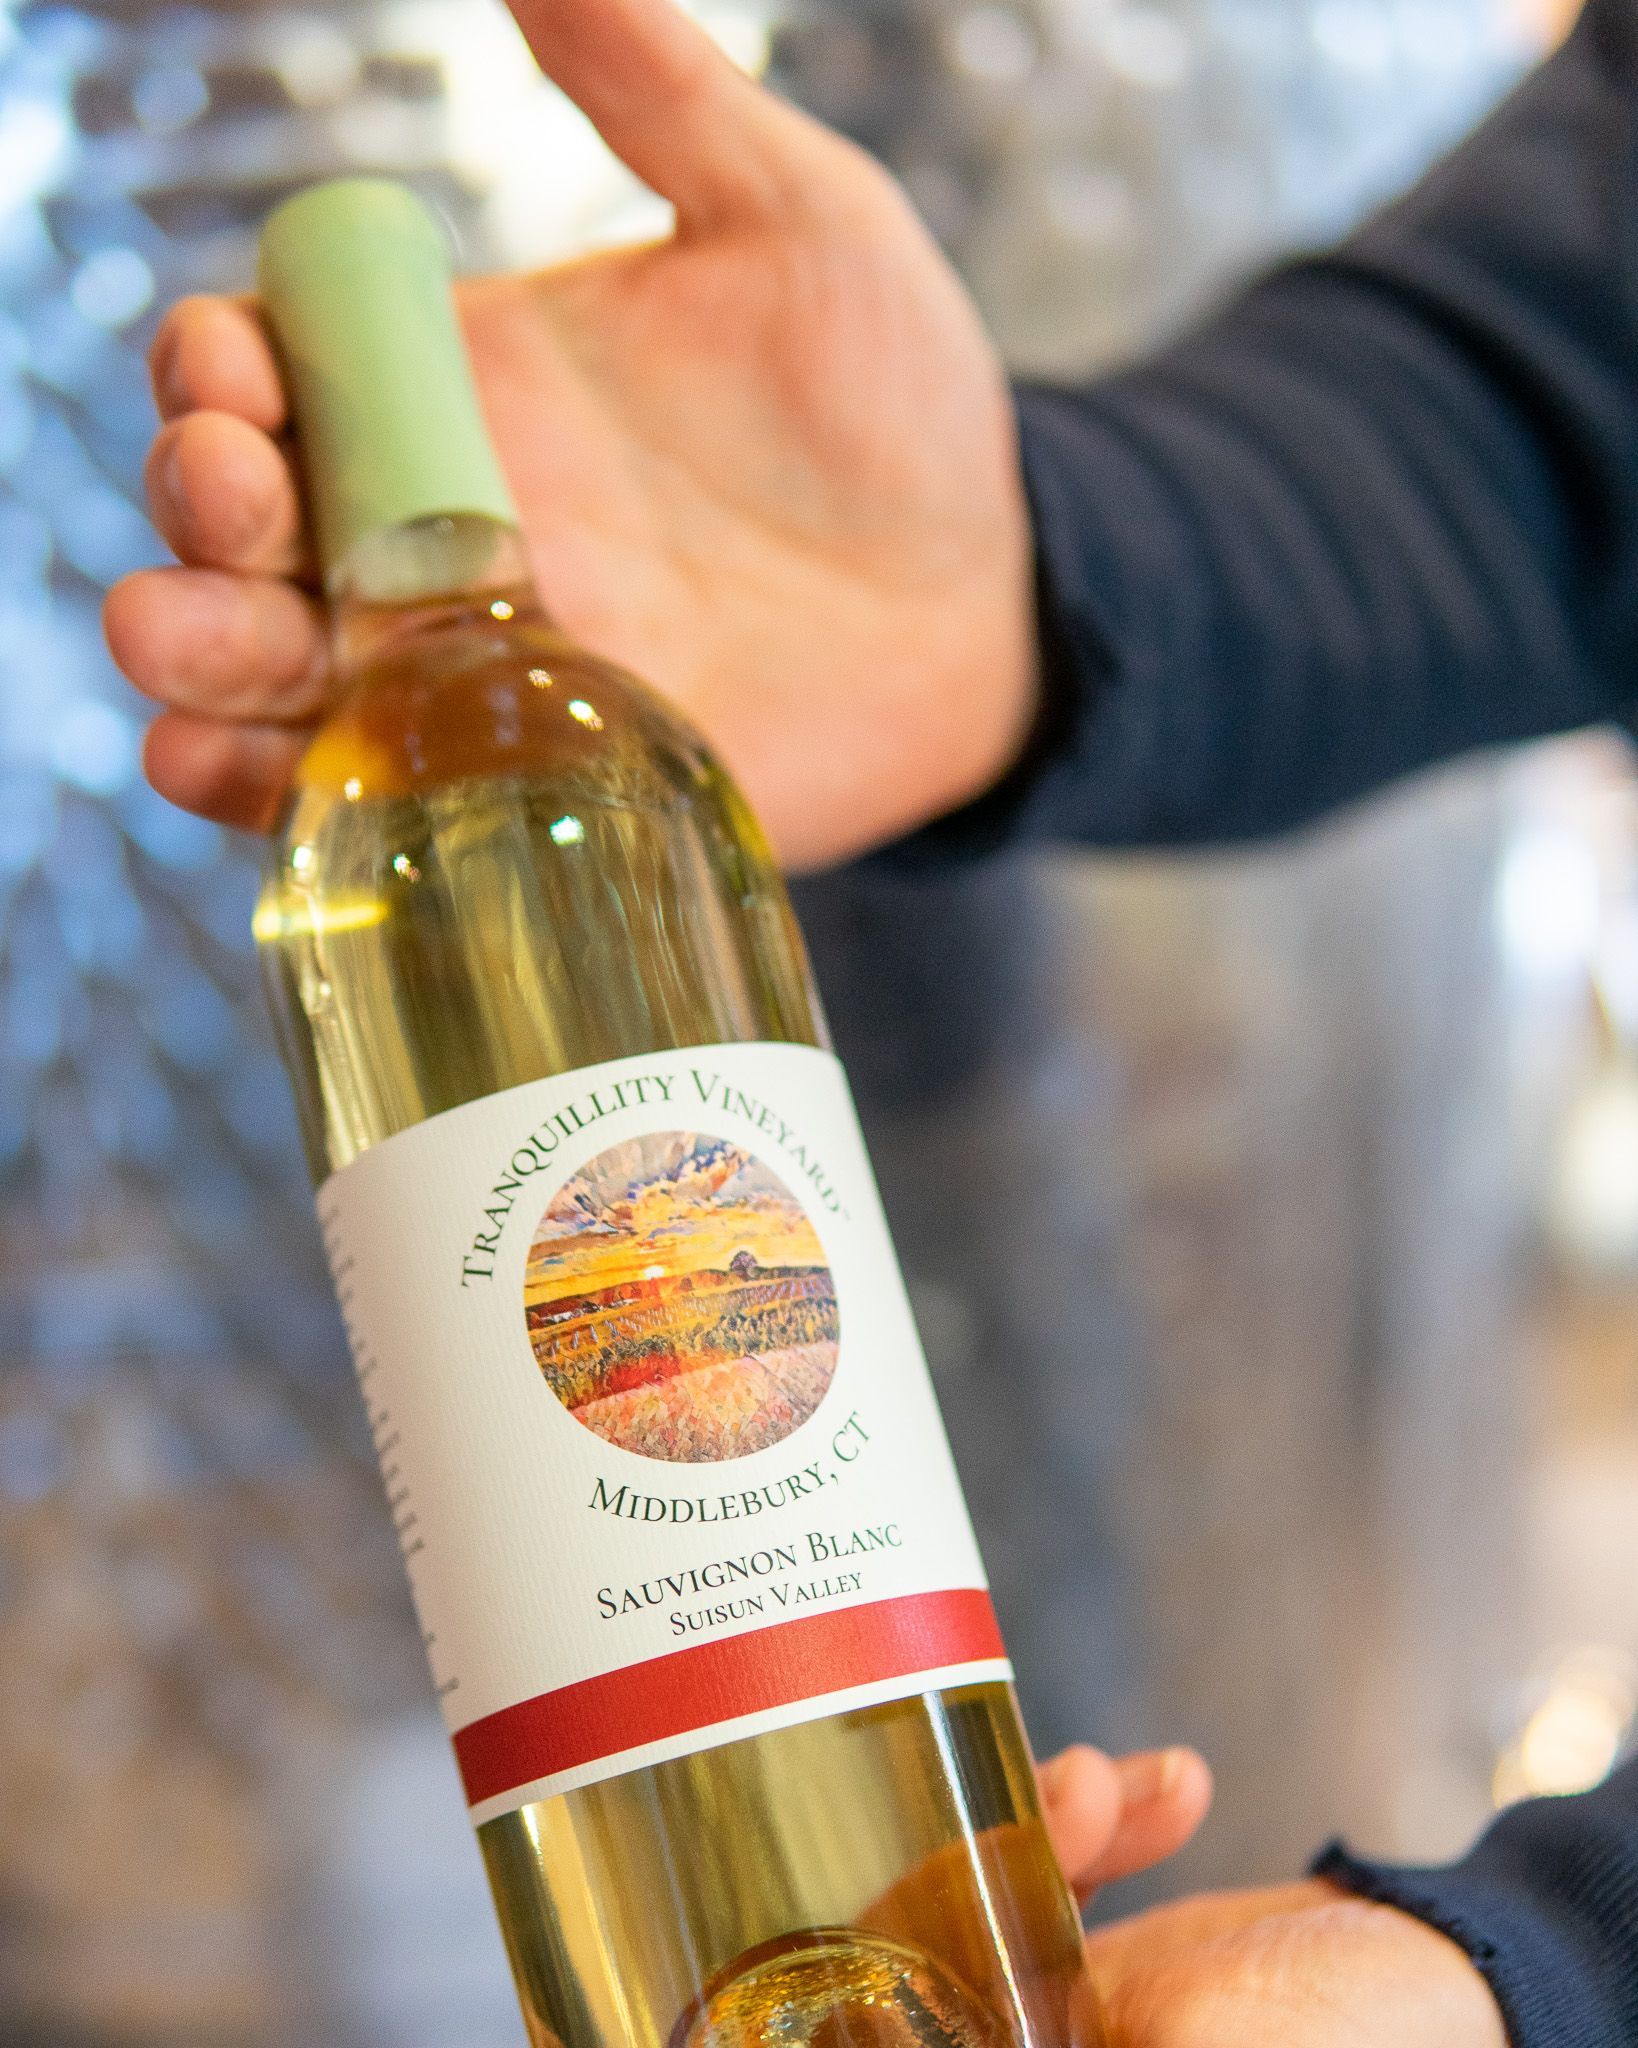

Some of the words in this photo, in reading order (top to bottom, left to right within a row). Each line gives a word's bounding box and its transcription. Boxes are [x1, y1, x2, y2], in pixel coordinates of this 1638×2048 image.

[461, 1074, 676, 1288] TRANQUILLITY
[588, 1461, 839, 1523] MIDDLEBURY,
[832, 1411, 871, 1462] CT
[597, 1544, 797, 1619] SAUVIGNON
[806, 1523, 903, 1562] BLANC
[670, 1595, 764, 1636] SUISUN
[769, 1572, 863, 1606] VALLEY
